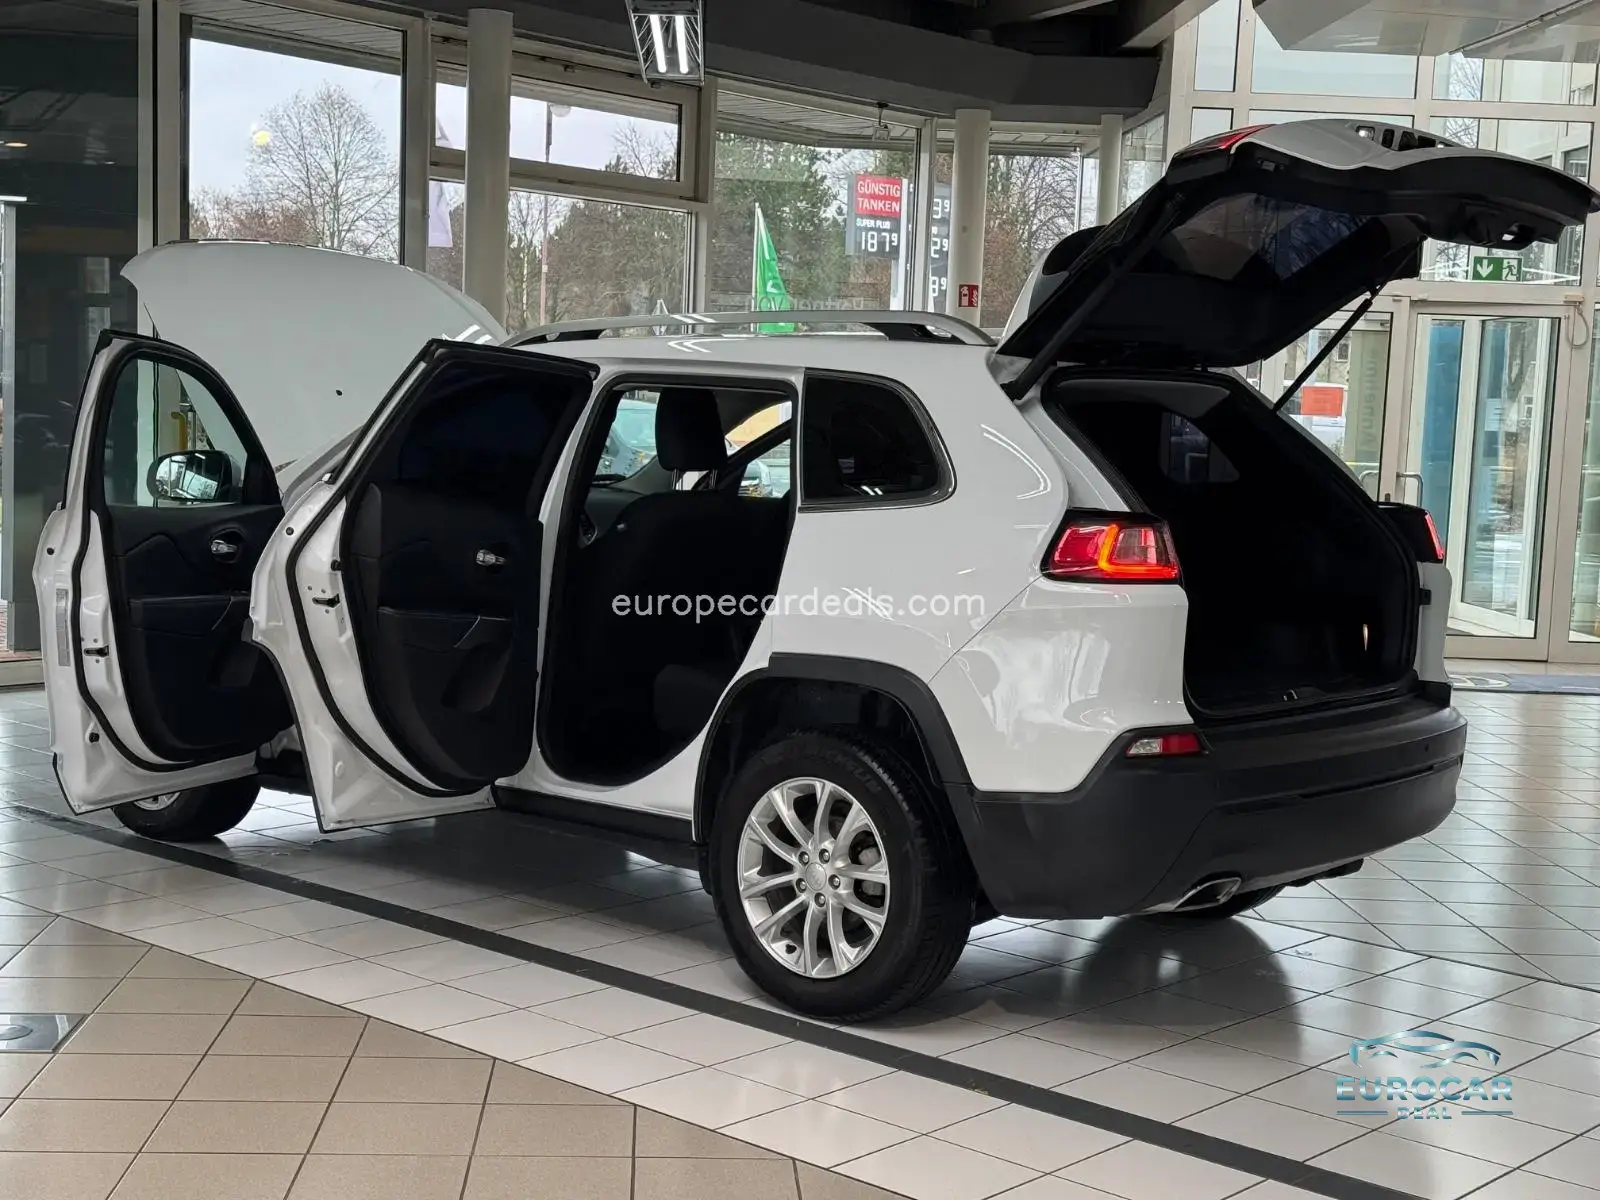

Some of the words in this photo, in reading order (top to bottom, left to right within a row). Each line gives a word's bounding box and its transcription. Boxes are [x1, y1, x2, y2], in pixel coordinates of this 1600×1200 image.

[857, 179, 901, 197] GÜNSTIG
[857, 198, 900, 213] TANKEN
[856, 218, 875, 228] SUPER
